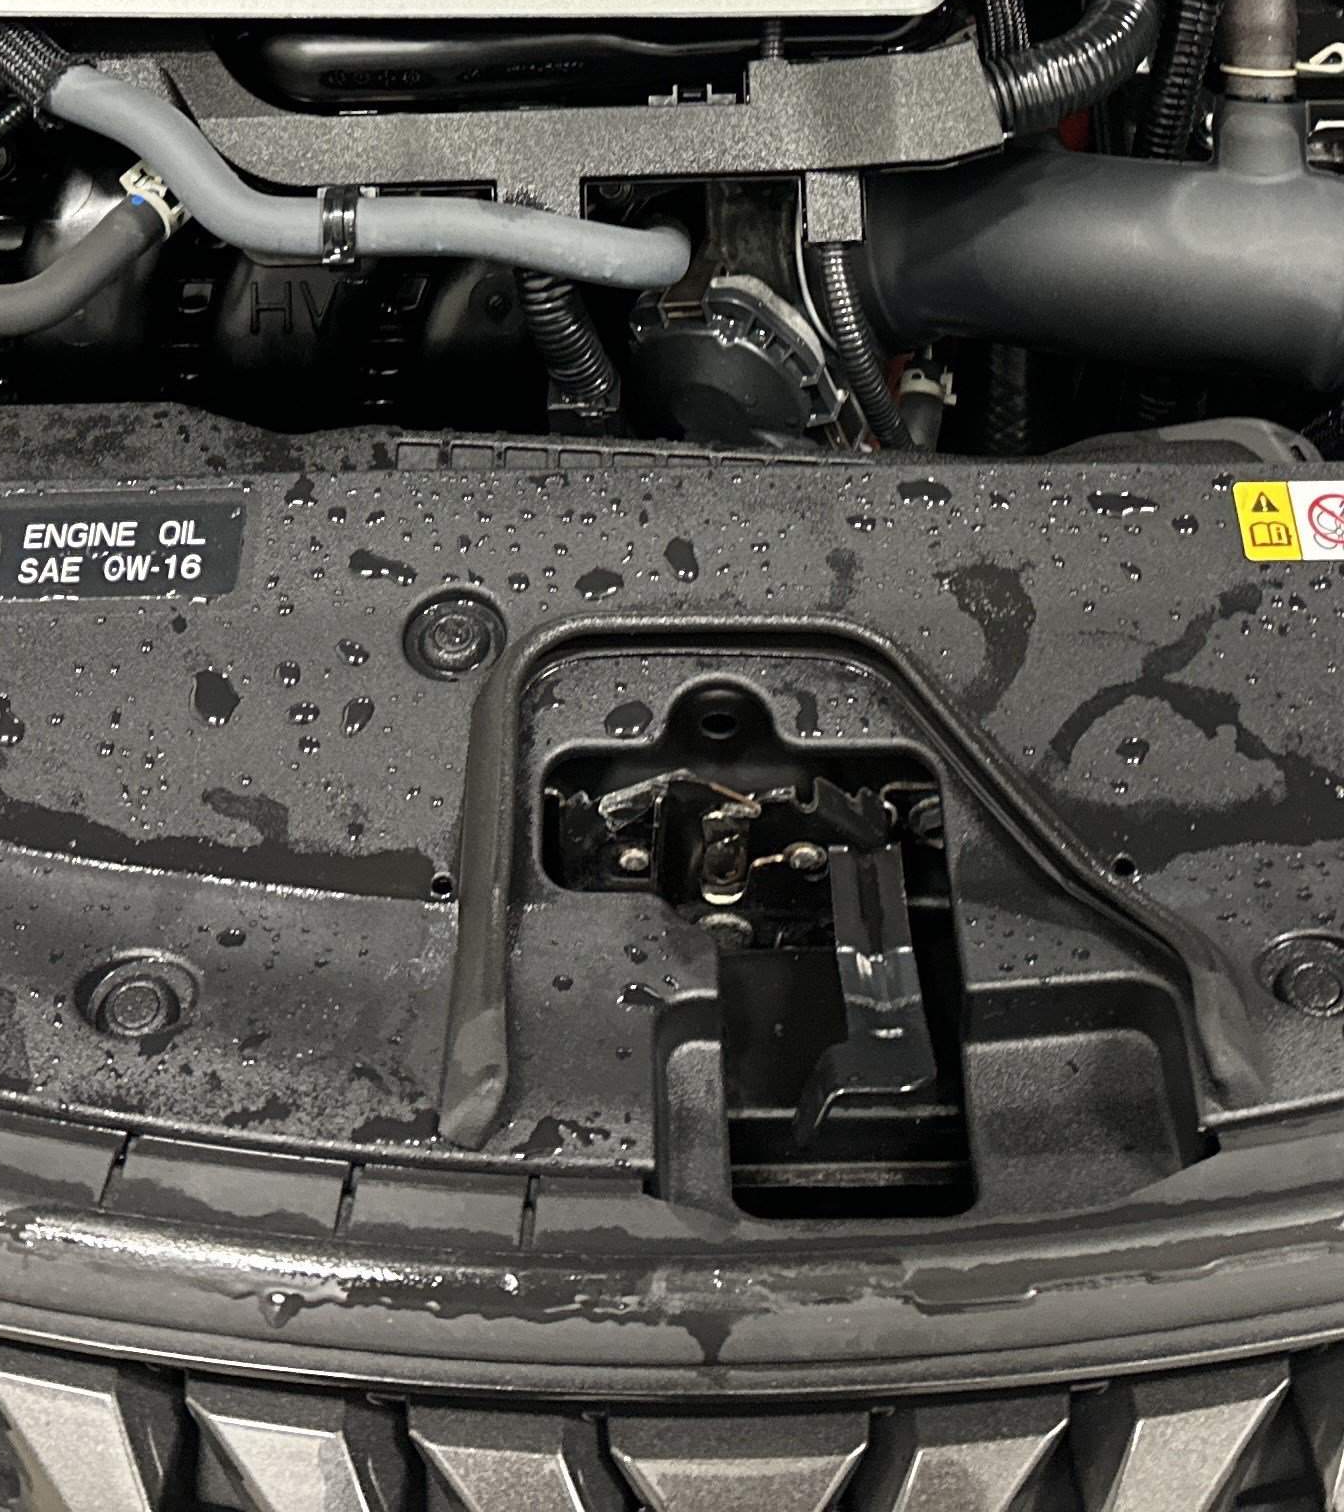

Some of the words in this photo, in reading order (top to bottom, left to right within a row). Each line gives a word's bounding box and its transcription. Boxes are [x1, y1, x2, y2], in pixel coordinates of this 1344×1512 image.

[250, 281, 341, 336] HV
[22, 521, 138, 549] ENGINE
[158, 520, 206, 546] OIL
[17, 556, 84, 584] SAE
